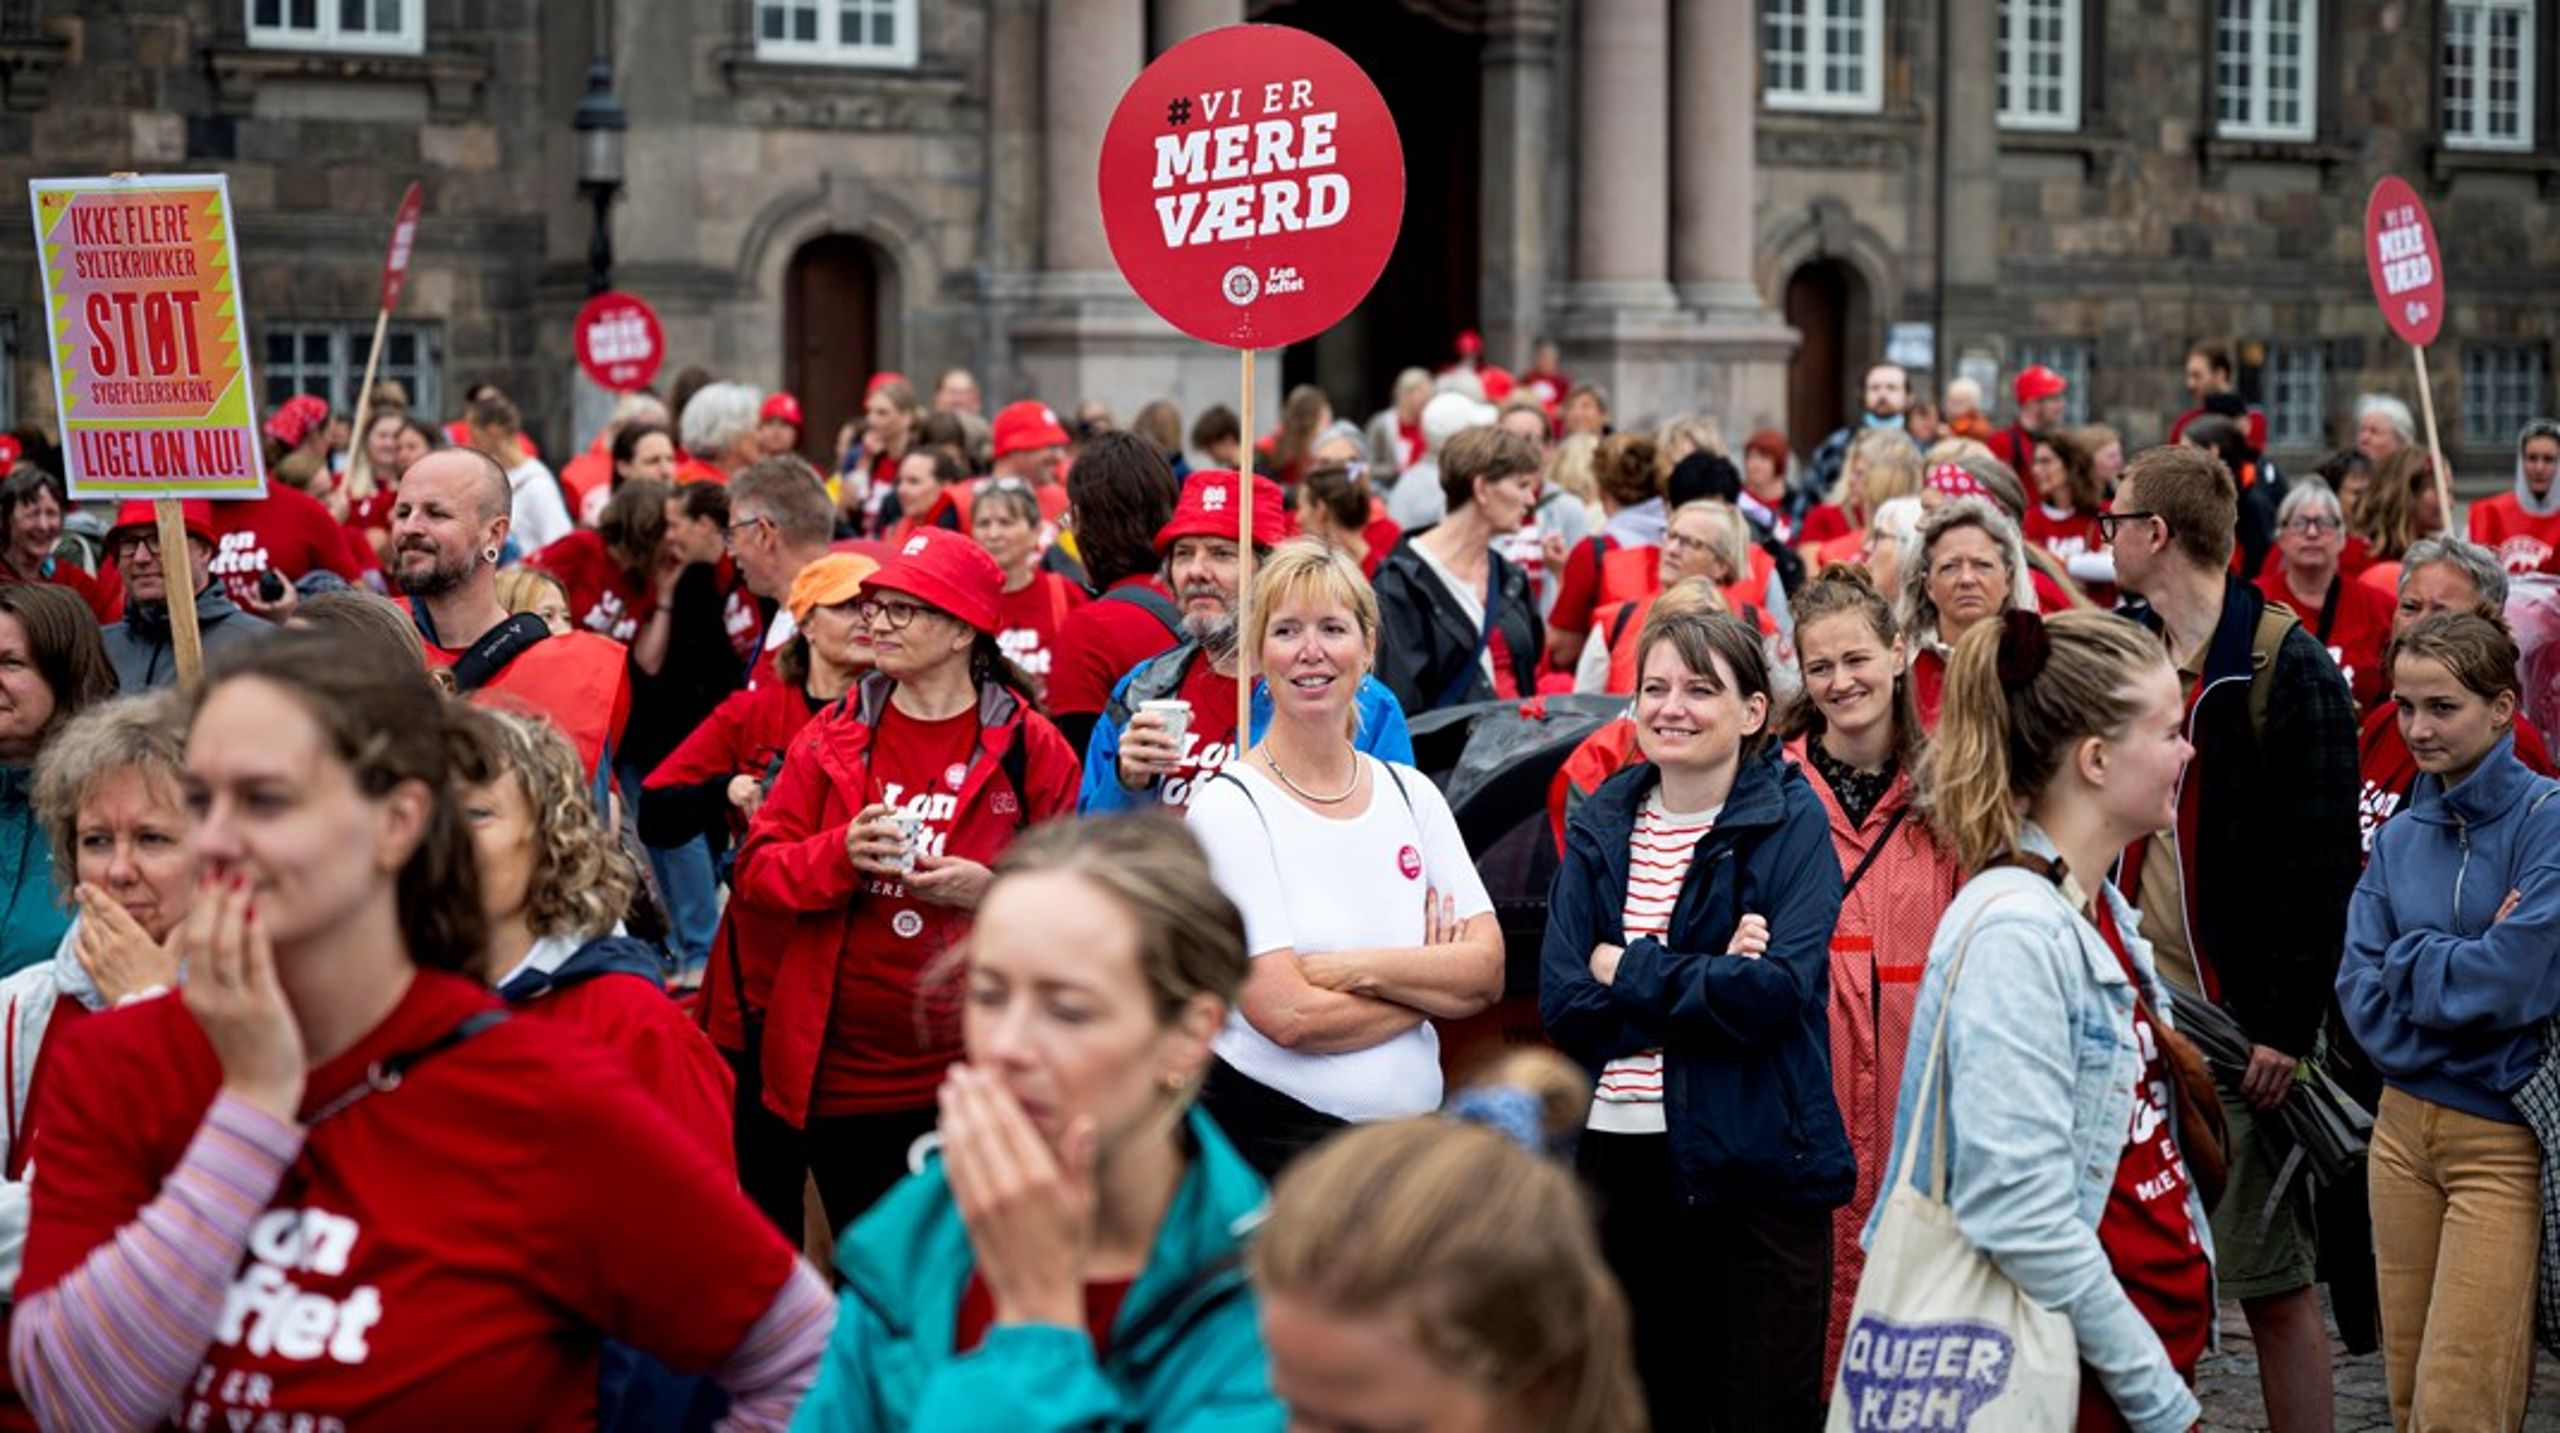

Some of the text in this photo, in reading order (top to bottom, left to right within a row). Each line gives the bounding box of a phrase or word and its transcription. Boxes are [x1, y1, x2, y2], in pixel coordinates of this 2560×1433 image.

[1263, 79, 1314, 113] ER
[1152, 112, 1337, 189] MERE
[70, 204, 192, 244] IKKE FLERE
[1155, 173, 1350, 247] VÆRD
[76, 249, 197, 278] SYLTEKRUKKER
[2378, 223, 2426, 266] MERE
[86, 291, 201, 376] STØT
[91, 381, 215, 405] SYGEPLEJERSKERNE
[80, 430, 245, 477] LIGELØN NU!
[870, 880, 905, 898] ERE
[2160, 1139, 2176, 1160] E
[1847, 1328, 2003, 1384] QUEER
[1858, 1387, 1964, 1431] KBH
